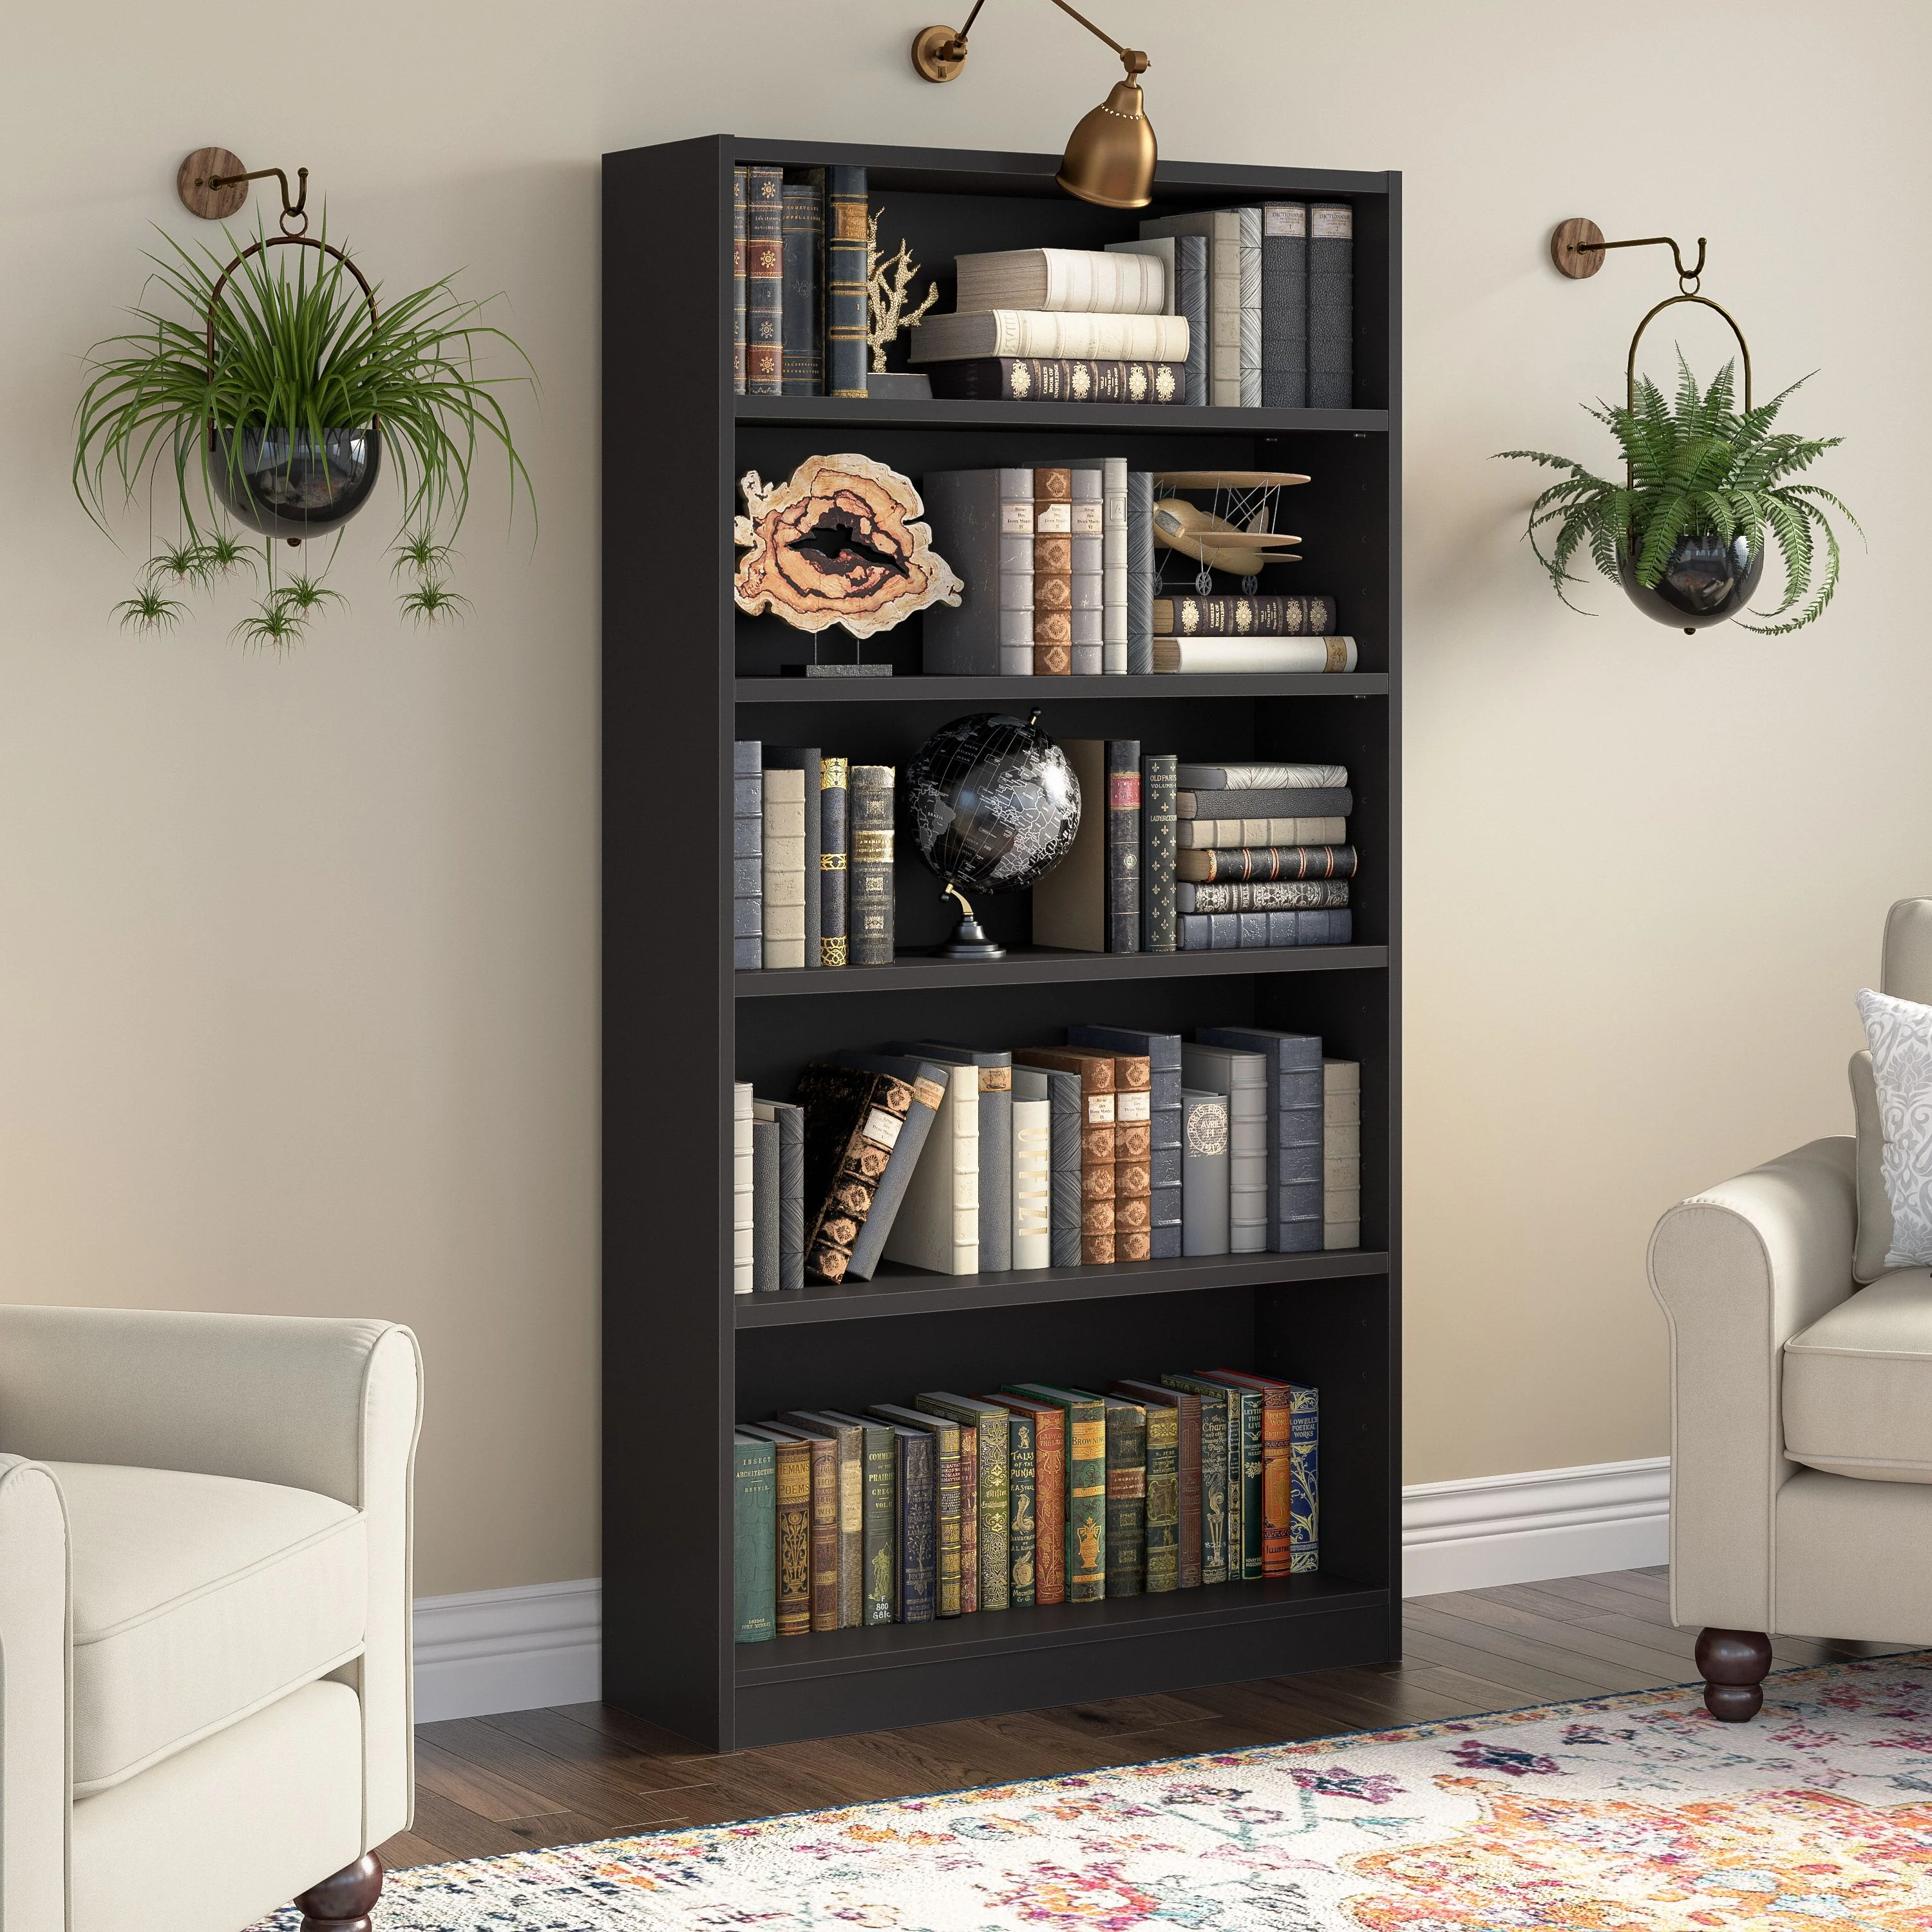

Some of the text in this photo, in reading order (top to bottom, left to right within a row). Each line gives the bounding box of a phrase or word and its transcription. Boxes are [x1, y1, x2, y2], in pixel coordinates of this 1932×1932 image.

[1048, 368, 1054, 376] OF
[1018, 1127, 1048, 1236] UFFIZI
[1290, 1417, 1318, 1425] LOWELL'S
[1202, 1423, 1227, 1432] Charm
[1072, 1435, 1105, 1446] BROWNING
[1010, 1450, 1034, 1461] TALES
[743, 1456, 771, 1466] INSECT
[777, 1463, 810, 1476] HEMANS
[818, 1477, 835, 1486] HOW
[777, 1483, 810, 1496] POEMS
[819, 1495, 835, 1504] LADY
[1074, 1574, 1104, 1582] LOVELL
